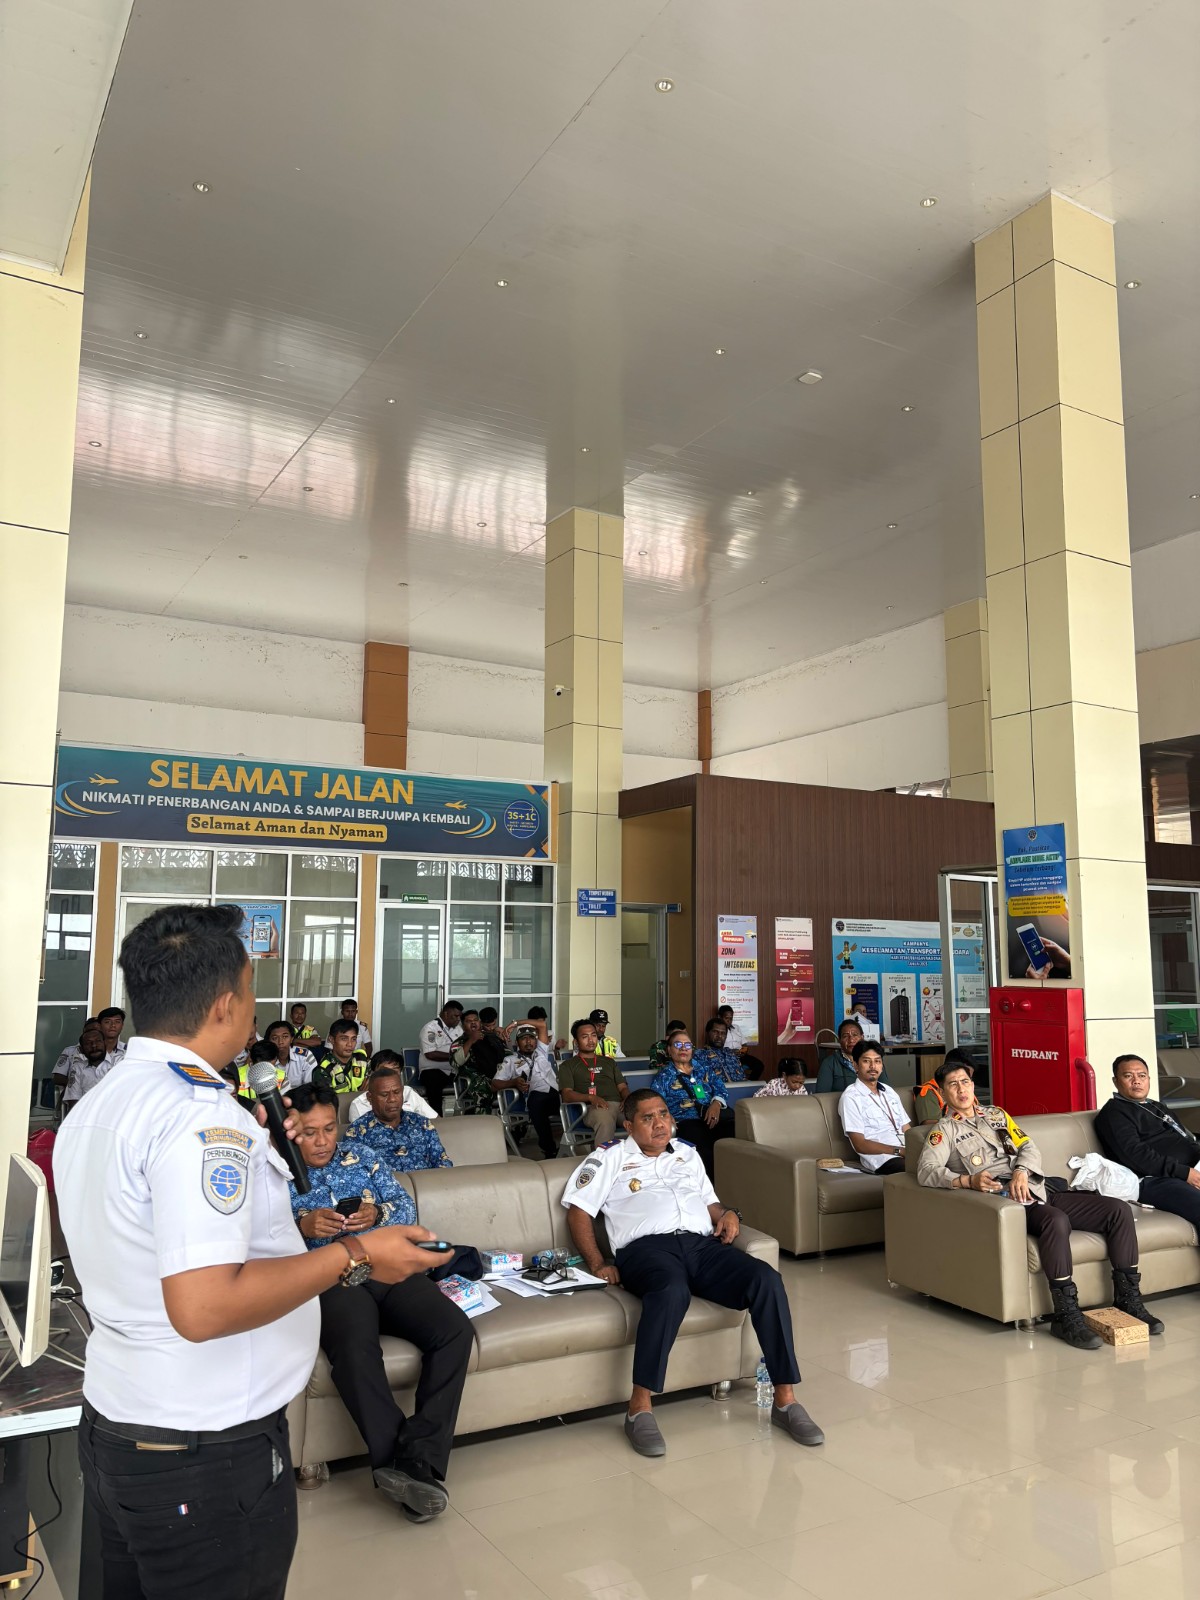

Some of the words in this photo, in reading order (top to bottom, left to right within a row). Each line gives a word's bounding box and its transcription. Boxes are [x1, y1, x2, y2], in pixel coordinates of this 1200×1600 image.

[148, 759, 308, 797] SELAMAT
[314, 772, 414, 805] JALAN
[82, 790, 144, 806] NIKMATI
[147, 794, 250, 812] PENERBANGAN
[252, 801, 291, 814] ANDA
[293, 804, 304, 815] &
[306, 805, 355, 818] SAMPAI
[357, 809, 420, 822] BERJUMPA
[422, 813, 471, 825] KEMBALI
[507, 811, 537, 821] 3S+1C
[190, 816, 251, 832] Selamat
[254, 820, 297, 834] Aman
[299, 821, 325, 835] dan
[328, 824, 385, 840] Nyaman
[721, 947, 736, 955] ZONA
[724, 960, 755, 969] INTEGRITAS
[1011, 1048, 1059, 1061] HYDRANT
[205, 1128, 248, 1142] KEMENTERIAN
[955, 1131, 975, 1144] ARIE
[206, 1150, 247, 1164] PERHUBUNGAN
